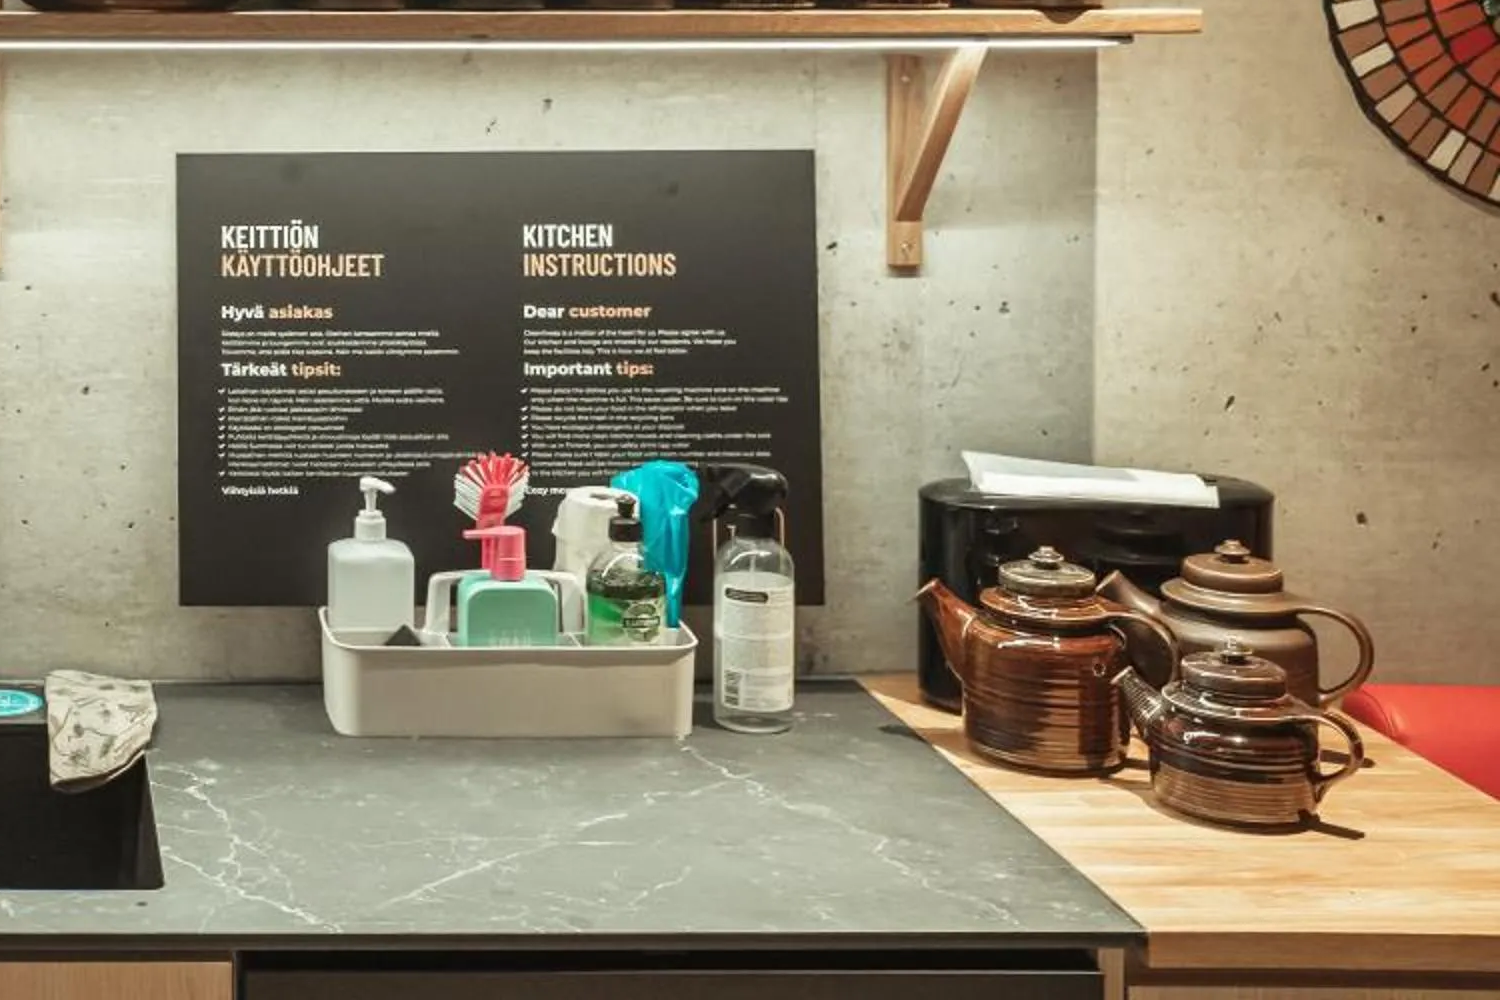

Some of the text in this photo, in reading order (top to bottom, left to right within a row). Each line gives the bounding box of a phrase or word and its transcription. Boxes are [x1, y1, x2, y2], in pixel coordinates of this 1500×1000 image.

[220, 219, 319, 249] KEITTIÖN
[523, 224, 613, 248] KITCHEN
[220, 250, 385, 277] KÄYTTÖOHJEET
[523, 253, 677, 277] INSTRUCTIONS
[221, 304, 333, 322] Hyvä asiakas
[523, 305, 652, 319] Dear customer
[220, 361, 341, 379] Tärkeät tipsit:
[523, 360, 655, 378] Important tips:
